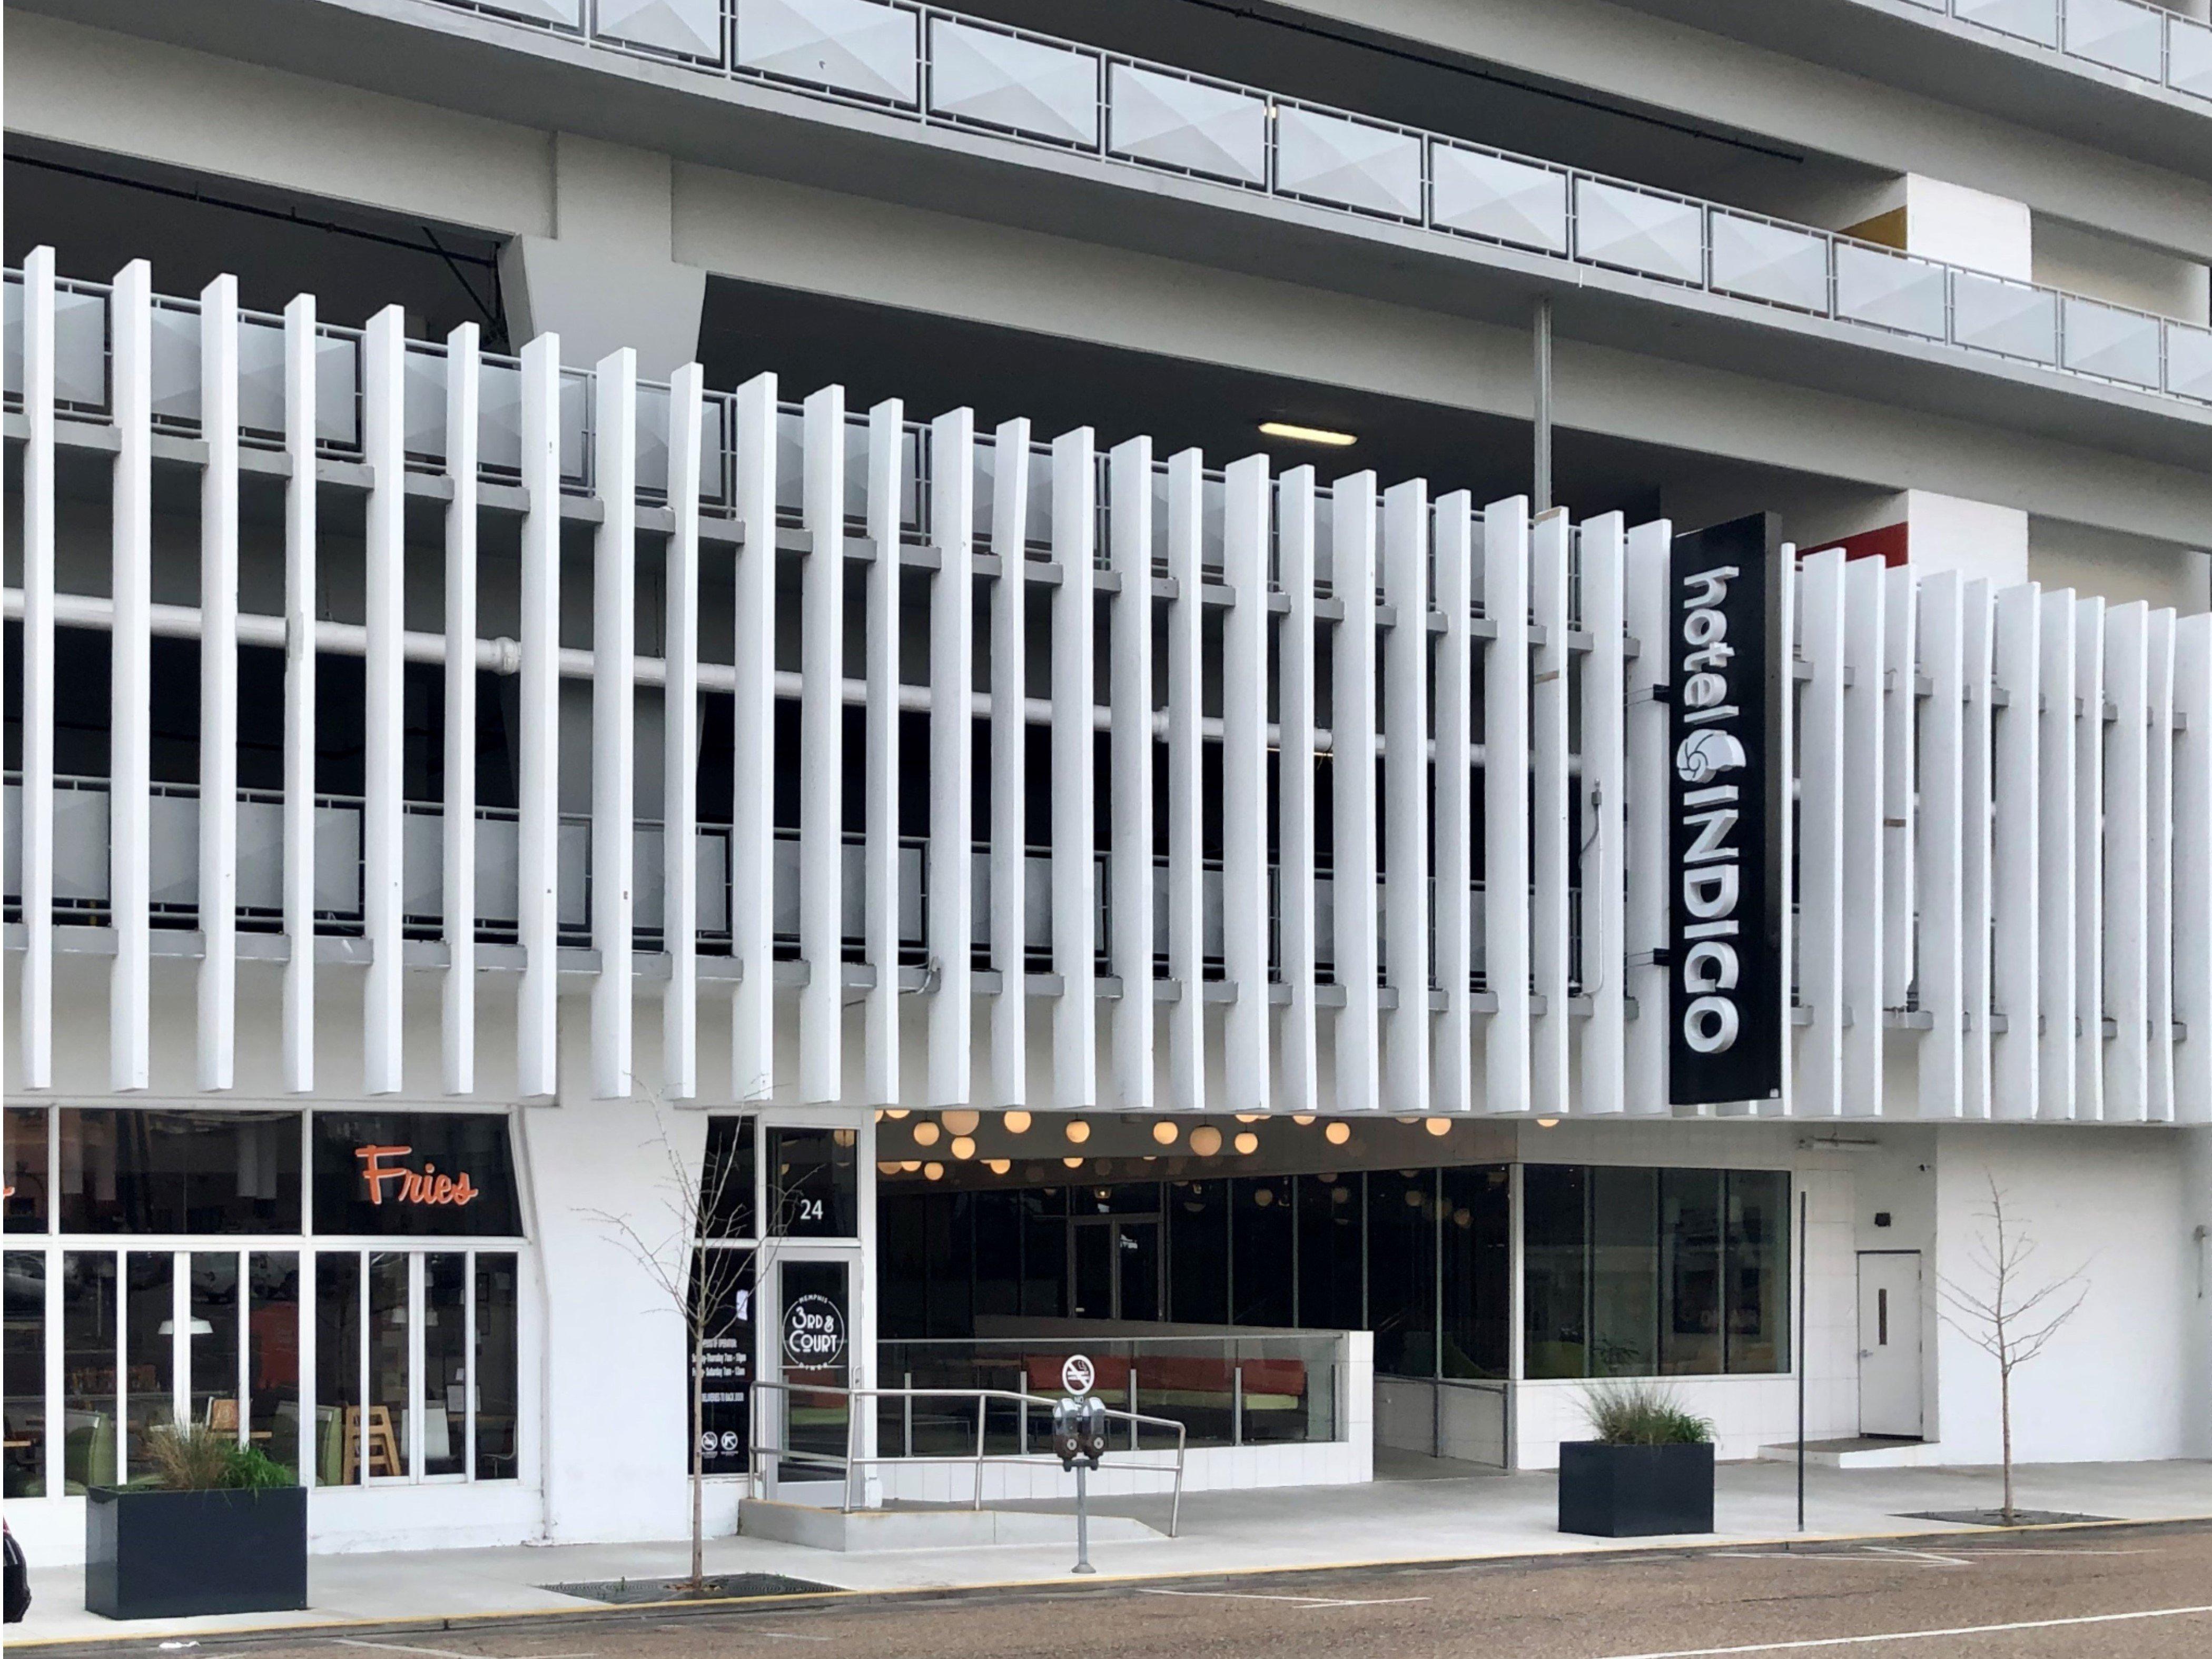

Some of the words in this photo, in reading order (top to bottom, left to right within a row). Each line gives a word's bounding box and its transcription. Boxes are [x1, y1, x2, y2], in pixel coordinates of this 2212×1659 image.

[1684, 566, 1739, 724] hotel
[1683, 785, 1739, 1052] INDIGO
[355, 1144, 478, 1205] Fries
[800, 1199, 824, 1220] 24
[789, 1329, 837, 1352] COURT
[792, 1306, 823, 1329] 3RD
[824, 1315, 834, 1333] &
